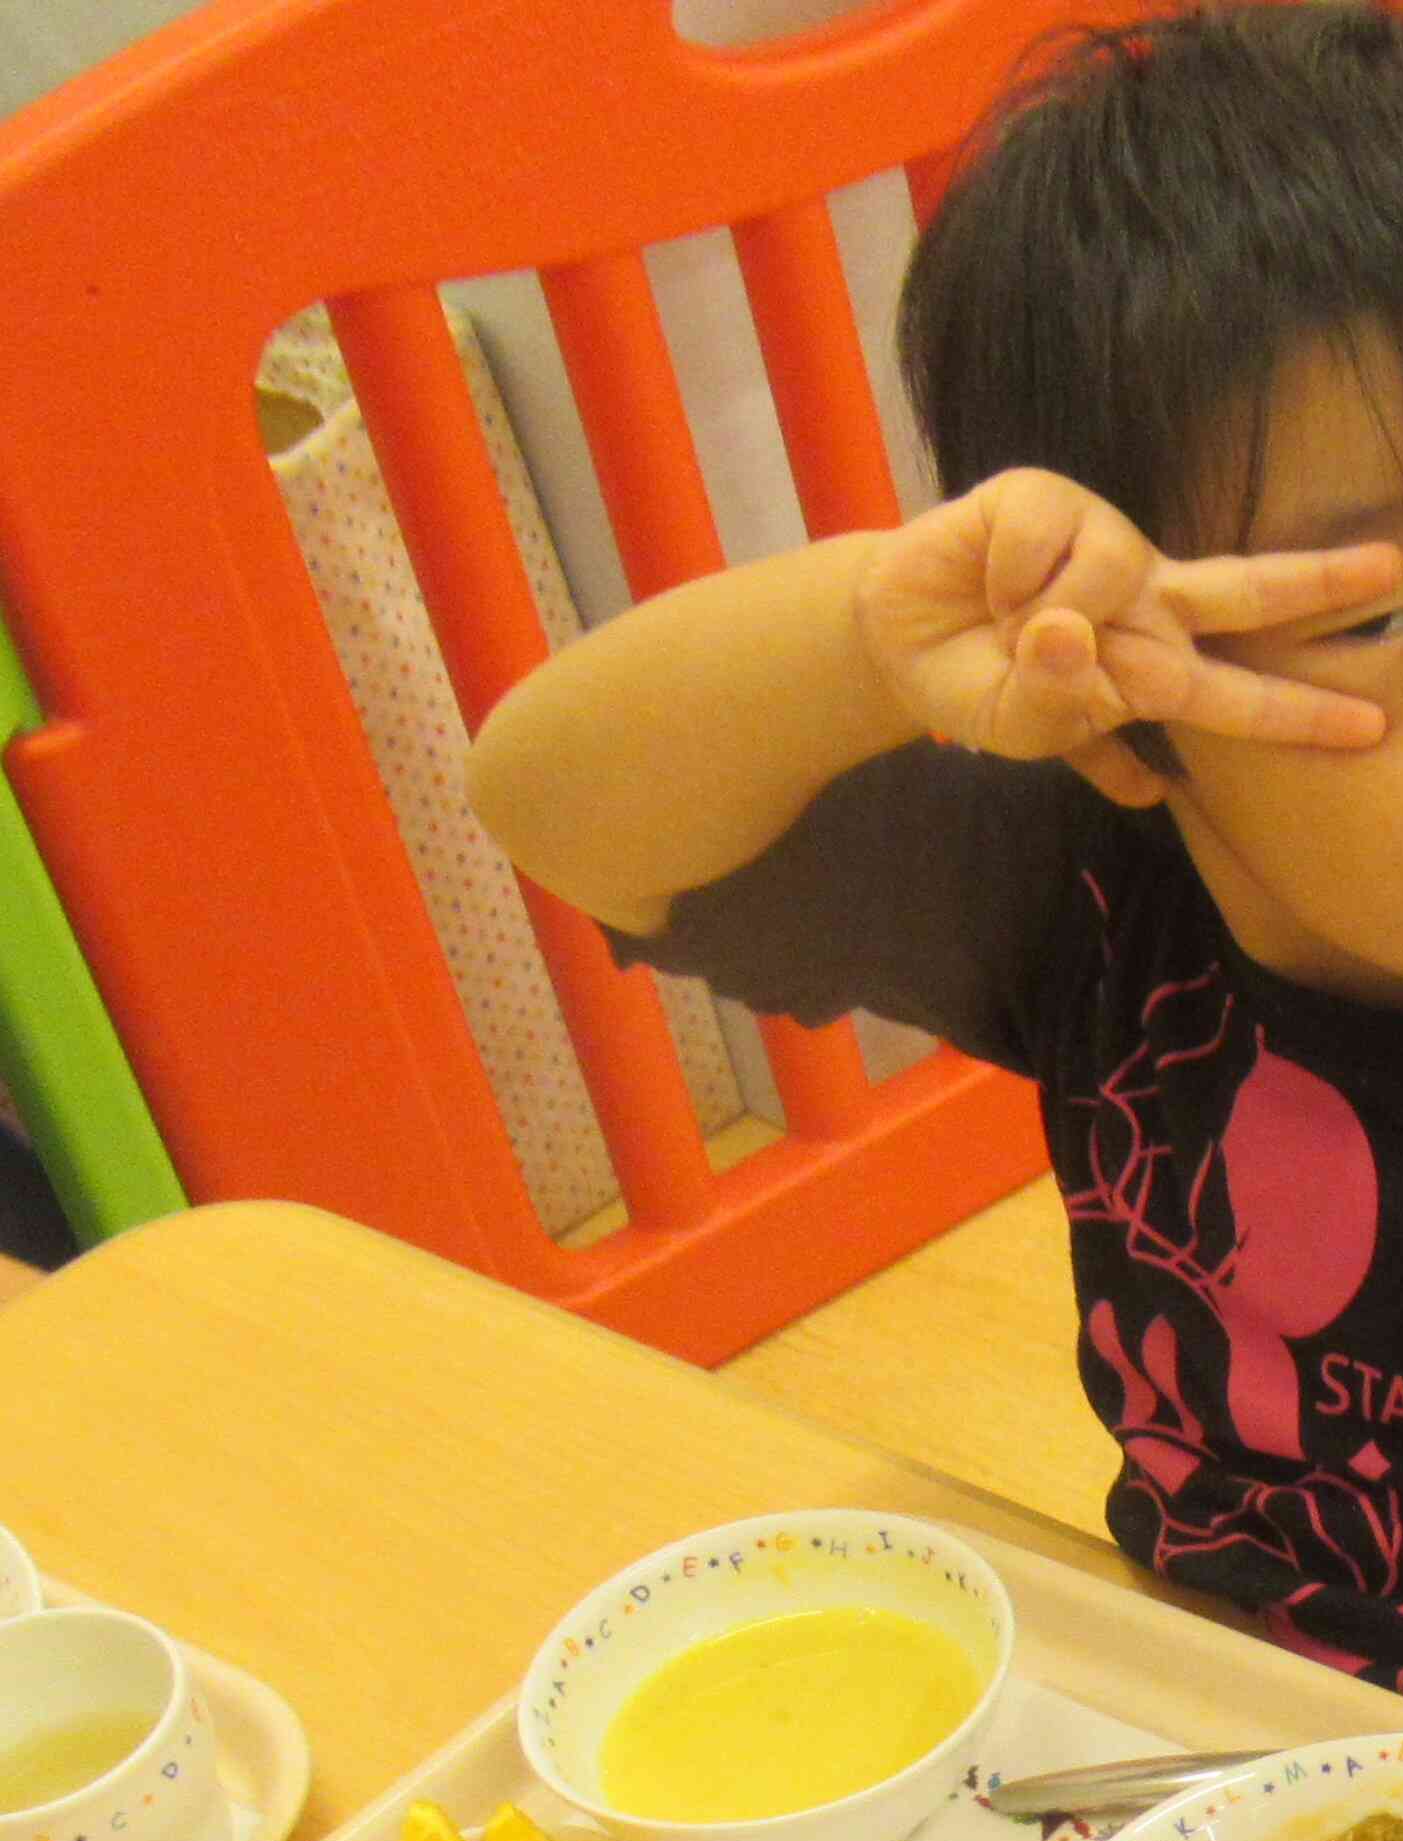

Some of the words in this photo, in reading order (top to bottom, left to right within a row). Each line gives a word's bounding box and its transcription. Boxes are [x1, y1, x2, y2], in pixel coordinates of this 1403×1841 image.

[629, 1585, 651, 1602] D
[682, 1556, 698, 1578] E
[878, 1531, 892, 1550] I
[1174, 1817, 1195, 1840] K
[1346, 1756, 1364, 1779] A
